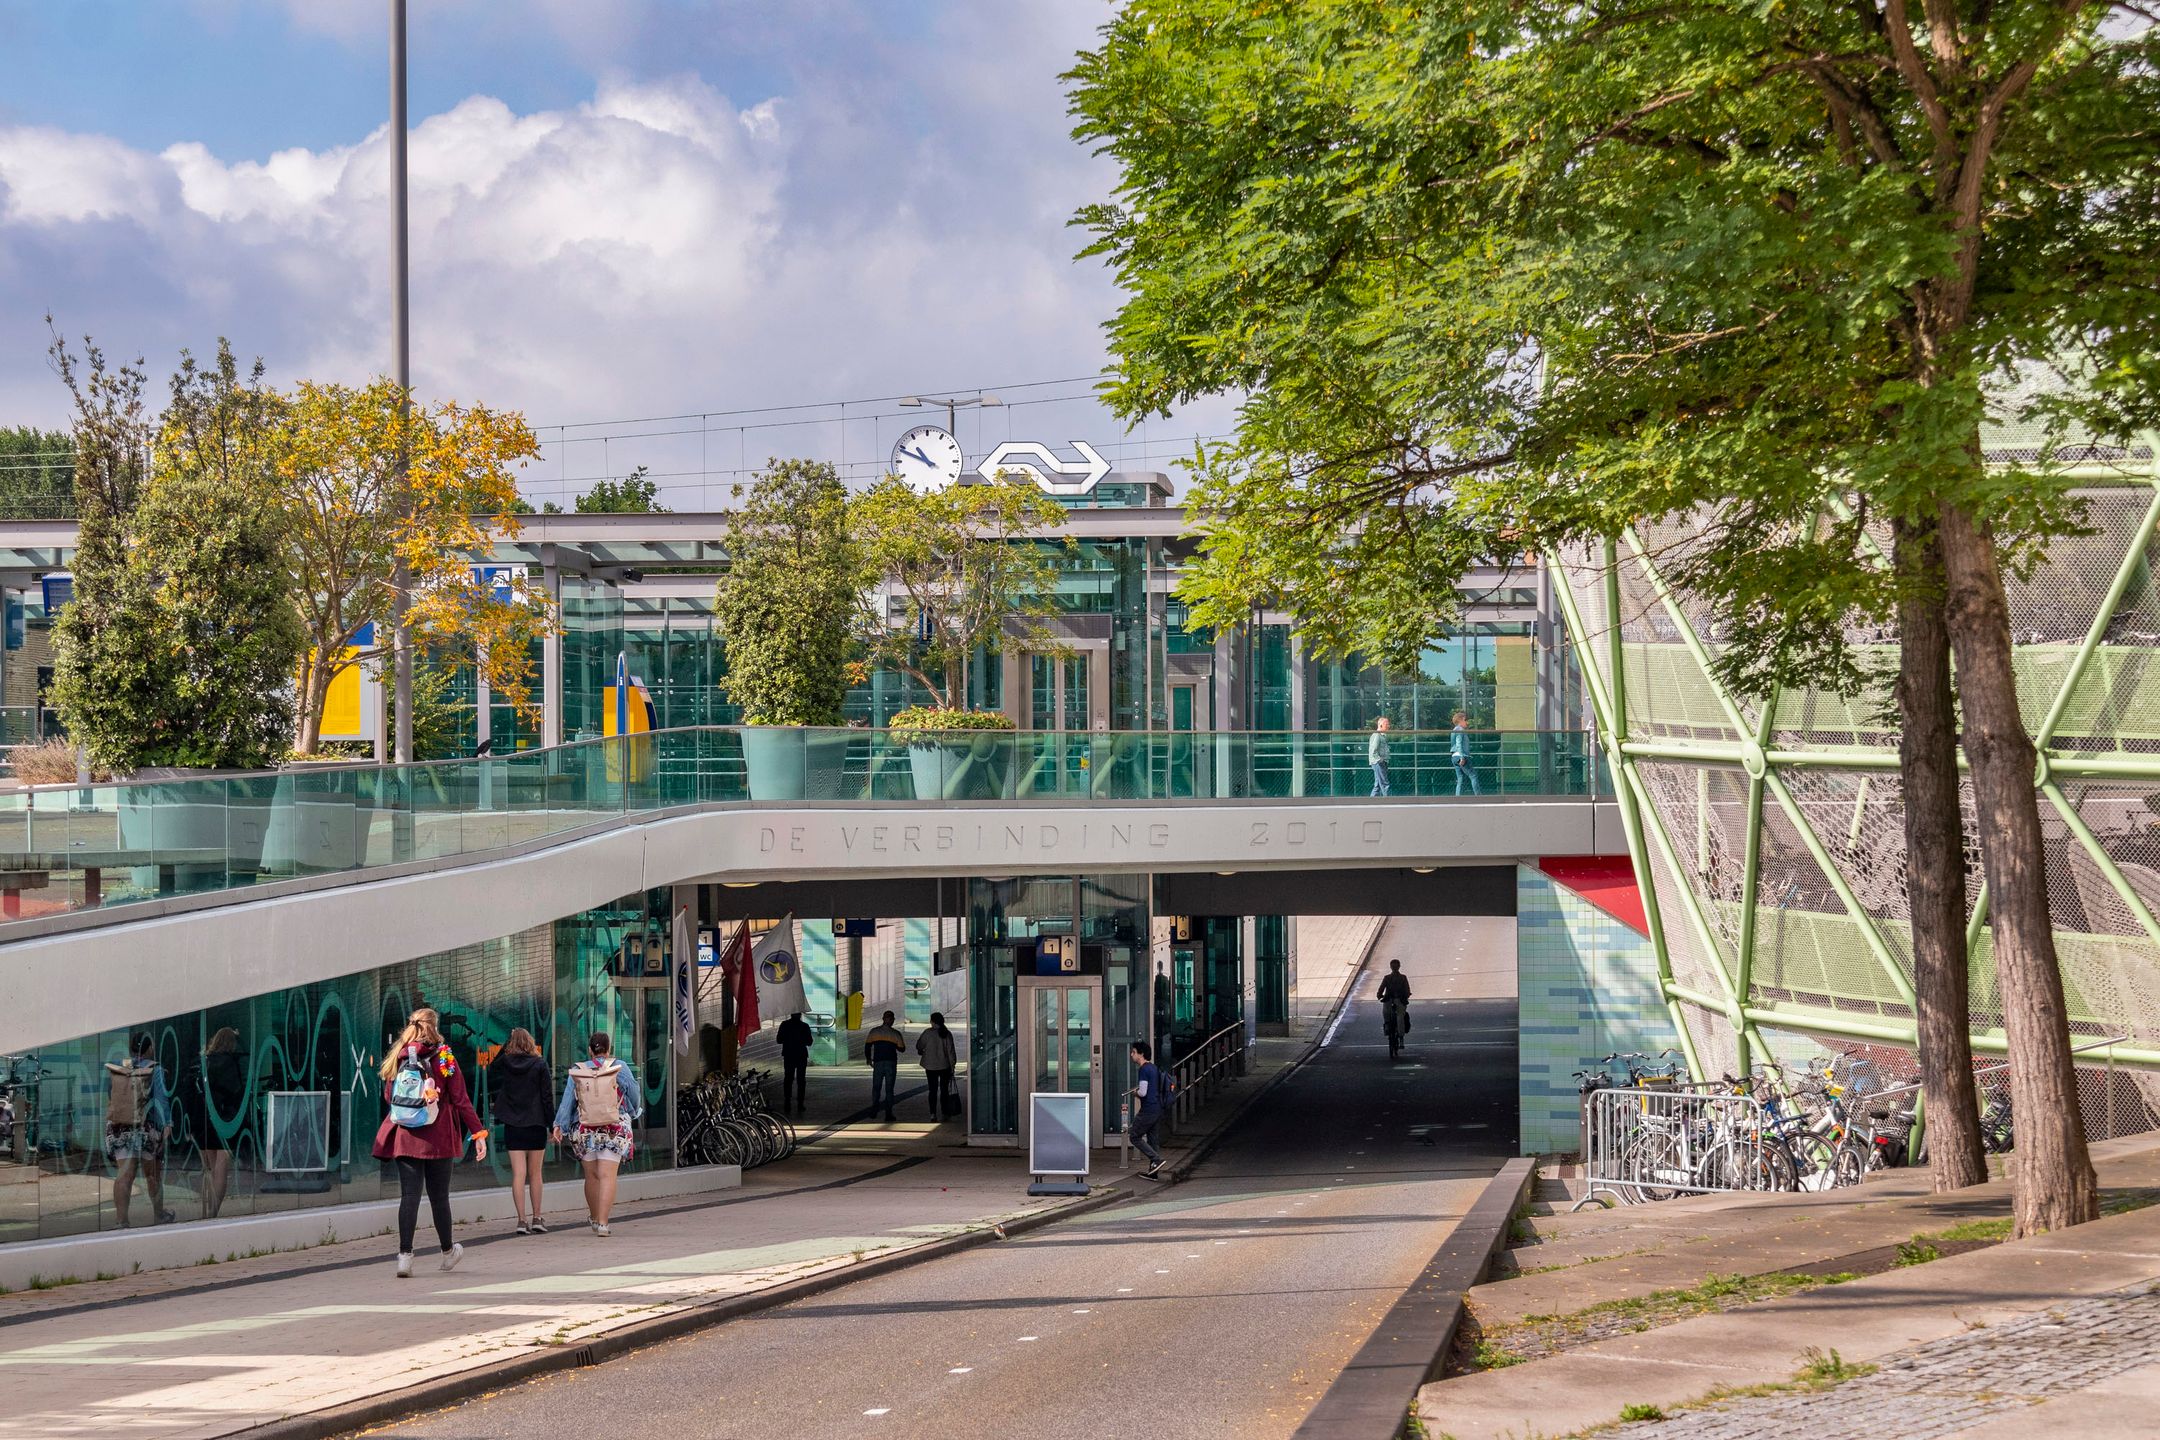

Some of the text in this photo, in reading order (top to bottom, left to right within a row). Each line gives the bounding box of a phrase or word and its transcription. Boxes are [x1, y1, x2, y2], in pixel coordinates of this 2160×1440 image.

[760, 820, 1383, 853] DE VERBINDING 2010
[703, 936, 708, 944] 1
[1049, 943, 1054, 952] 1
